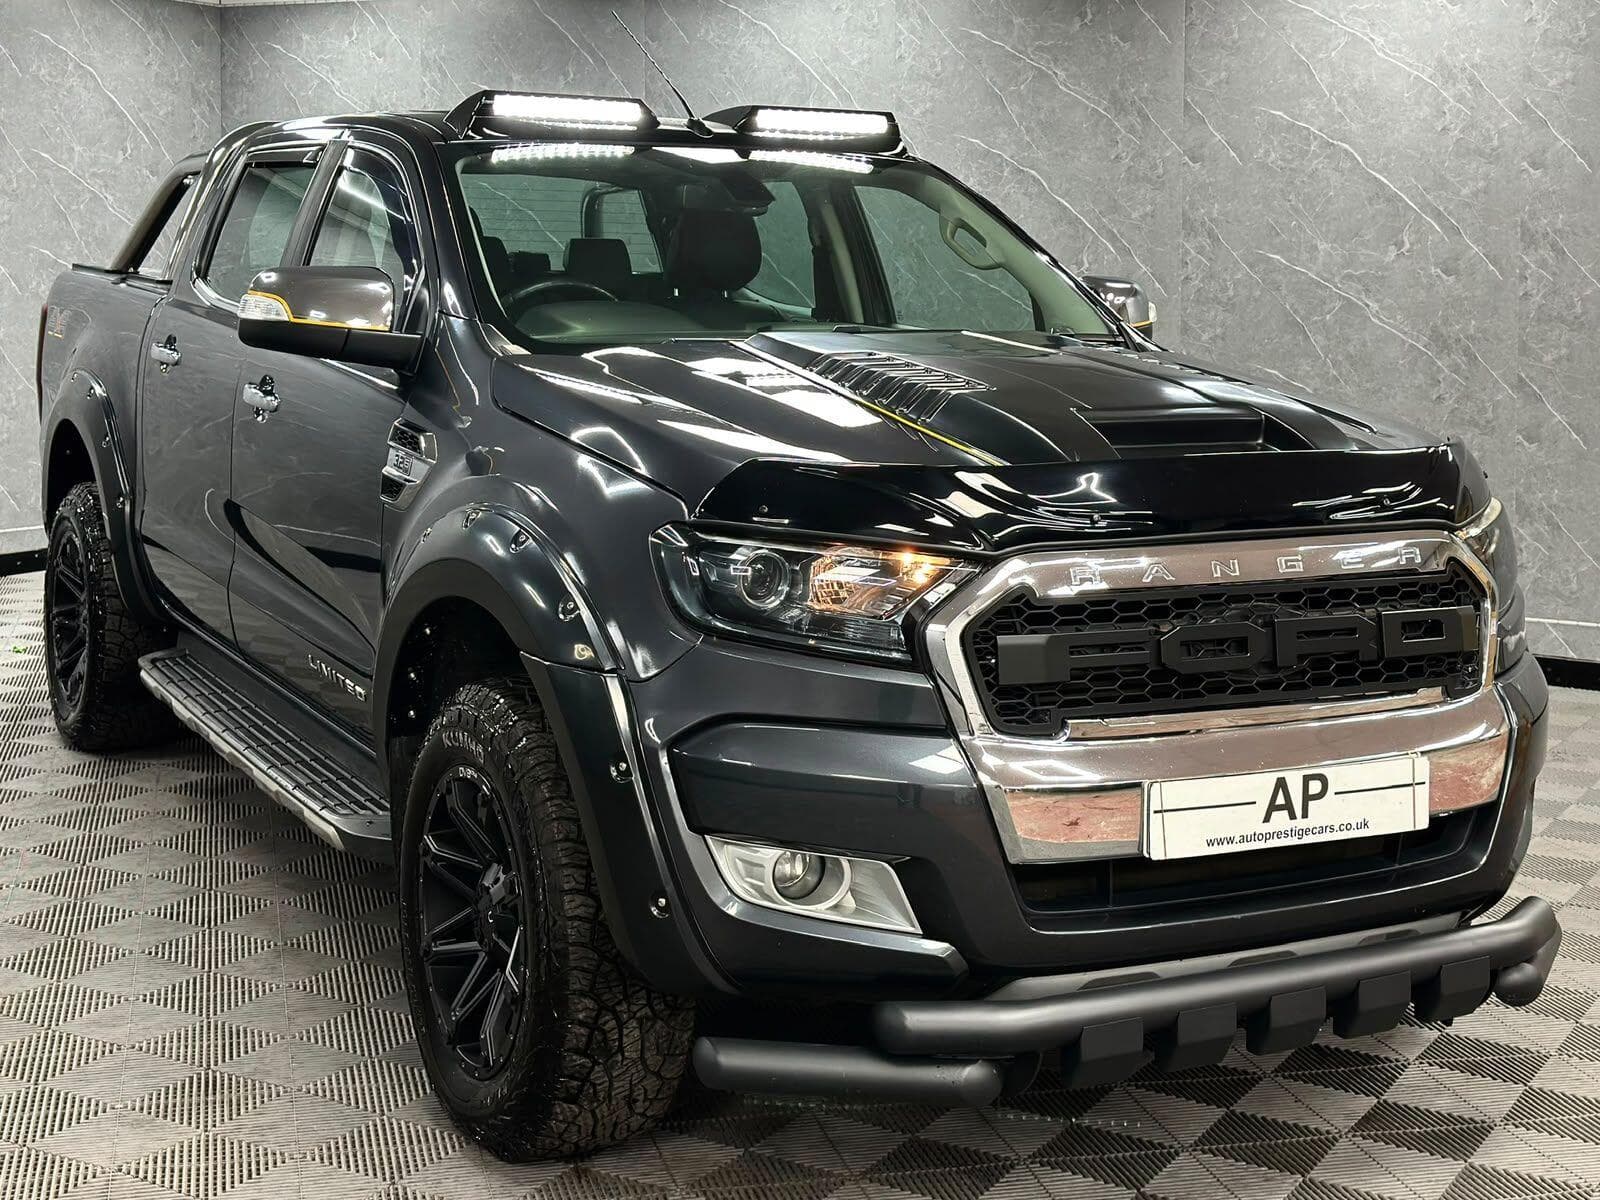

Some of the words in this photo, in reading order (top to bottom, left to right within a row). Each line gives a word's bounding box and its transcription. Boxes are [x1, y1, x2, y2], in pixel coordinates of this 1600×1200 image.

[1069, 546, 1422, 587] RANGER
[996, 605, 1479, 685] FORD
[308, 654, 366, 702] LIMITED
[442, 730, 484, 764] KUMHO
[1262, 772, 1329, 824] AP
[1205, 818, 1370, 847] www.autoprestigecars.co.uk
